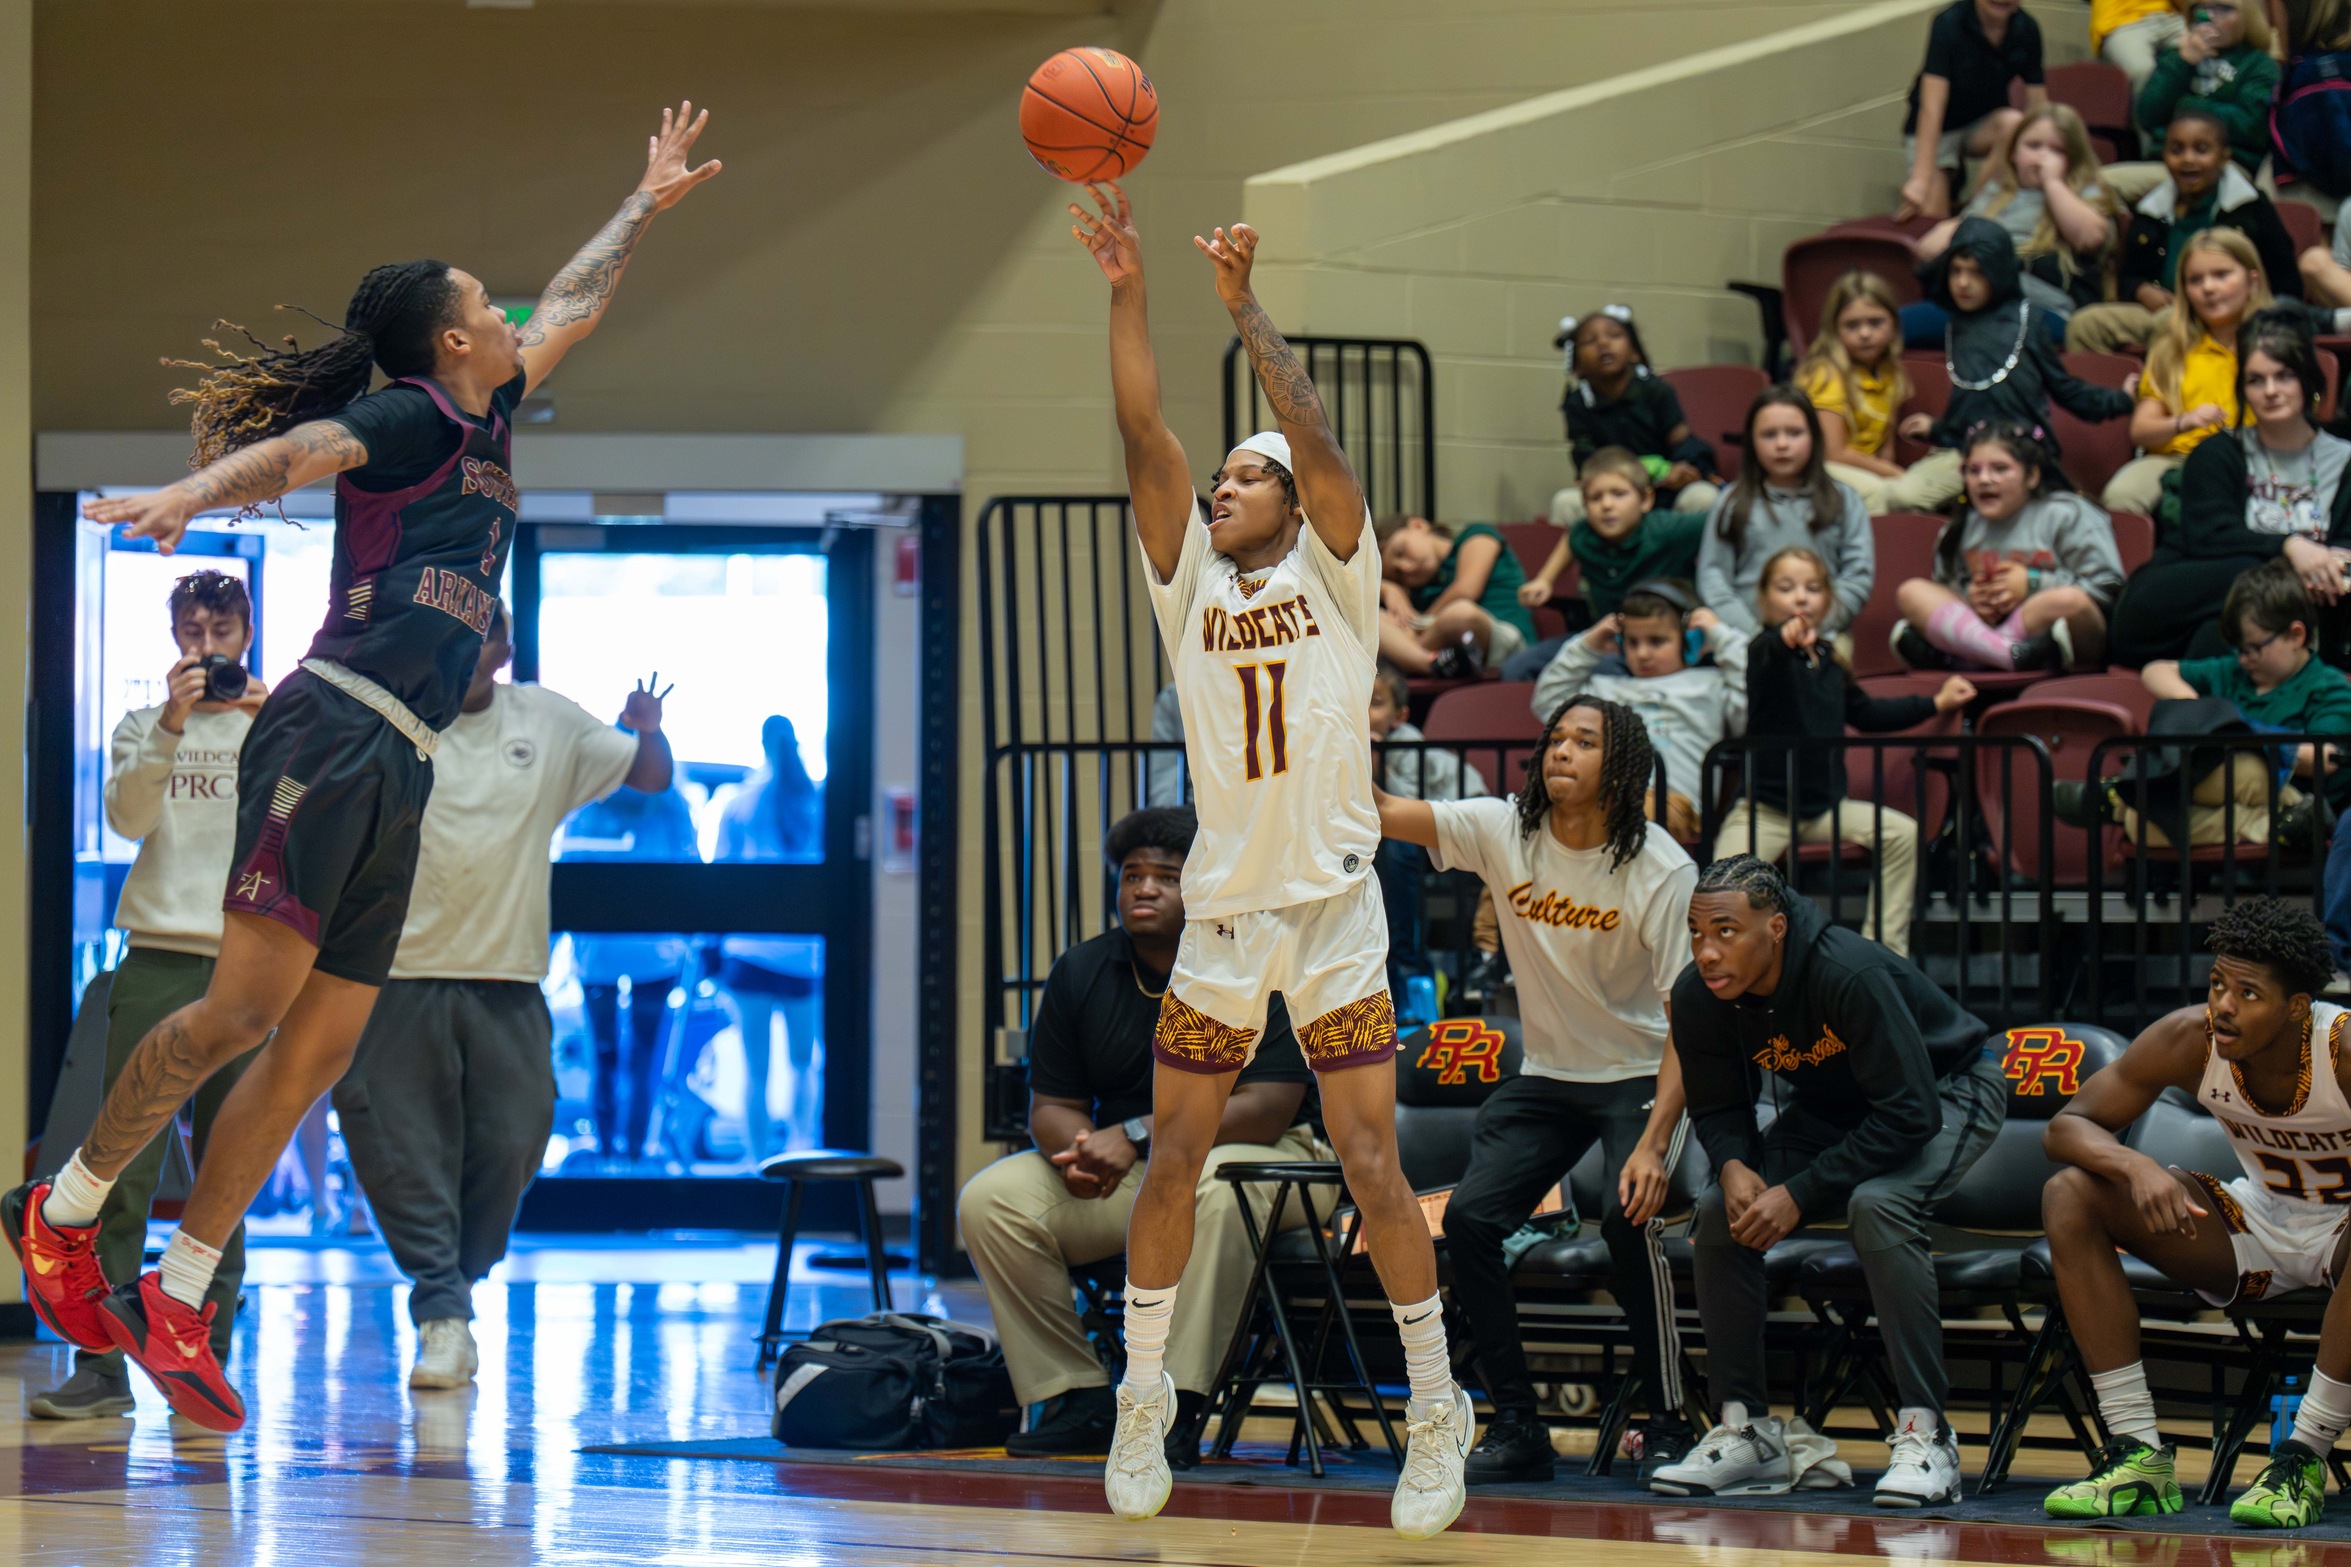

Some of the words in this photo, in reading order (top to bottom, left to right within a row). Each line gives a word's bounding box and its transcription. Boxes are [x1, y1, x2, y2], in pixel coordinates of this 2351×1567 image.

[1202, 594, 1321, 652] WILDCATS
[1232, 659, 1289, 783] 11
[170, 773, 239, 800] PRC
[1507, 880, 1621, 932] Culture
[2218, 1114, 2351, 1152] WILDCATS
